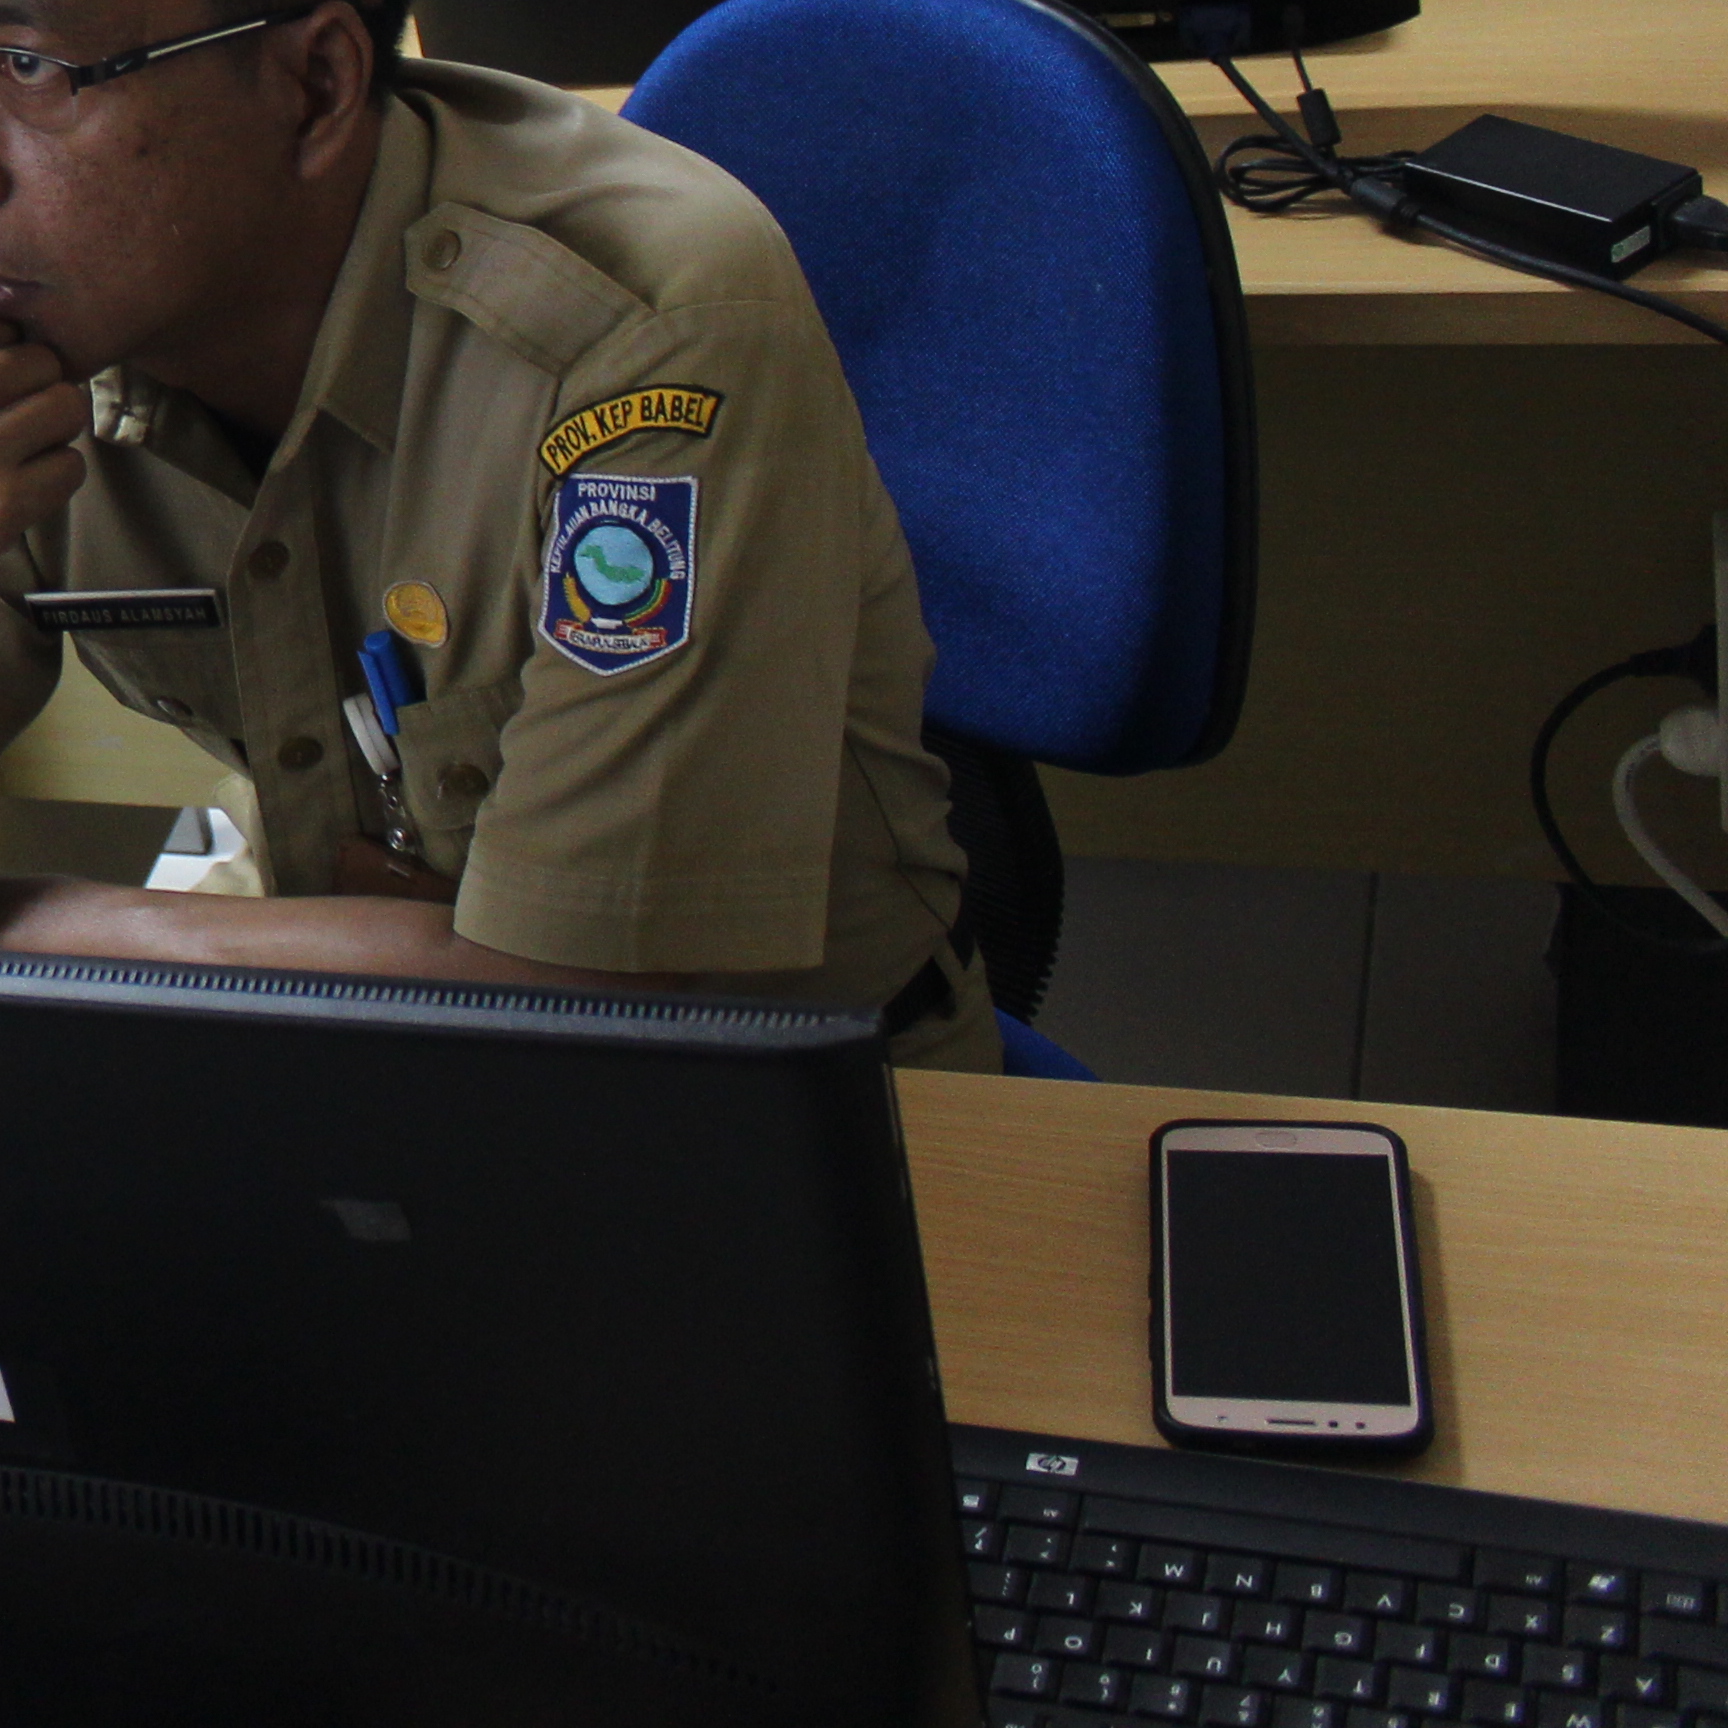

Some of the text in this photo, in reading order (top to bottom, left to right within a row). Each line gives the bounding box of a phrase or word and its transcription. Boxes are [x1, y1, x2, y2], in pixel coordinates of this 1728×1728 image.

[546, 391, 705, 470] PROV. KEP BABEL
[577, 481, 656, 502] PROVINSI
[588, 499, 648, 526] BANGKA
[647, 518, 688, 581] BELITUNG
[42, 606, 207, 625] FIRDAUS ALAMSYAH
[1163, 1562, 1185, 1579] M
[1234, 1572, 1254, 1589] N
[1065, 1590, 1076, 1607] L
[1376, 1593, 1394, 1609] V
[1128, 1600, 1144, 1617] K
[1002, 1626, 1017, 1642] P
[1264, 1620, 1283, 1637] H
[1205, 1656, 1223, 1674] U
[1277, 1667, 1293, 1684] Y
